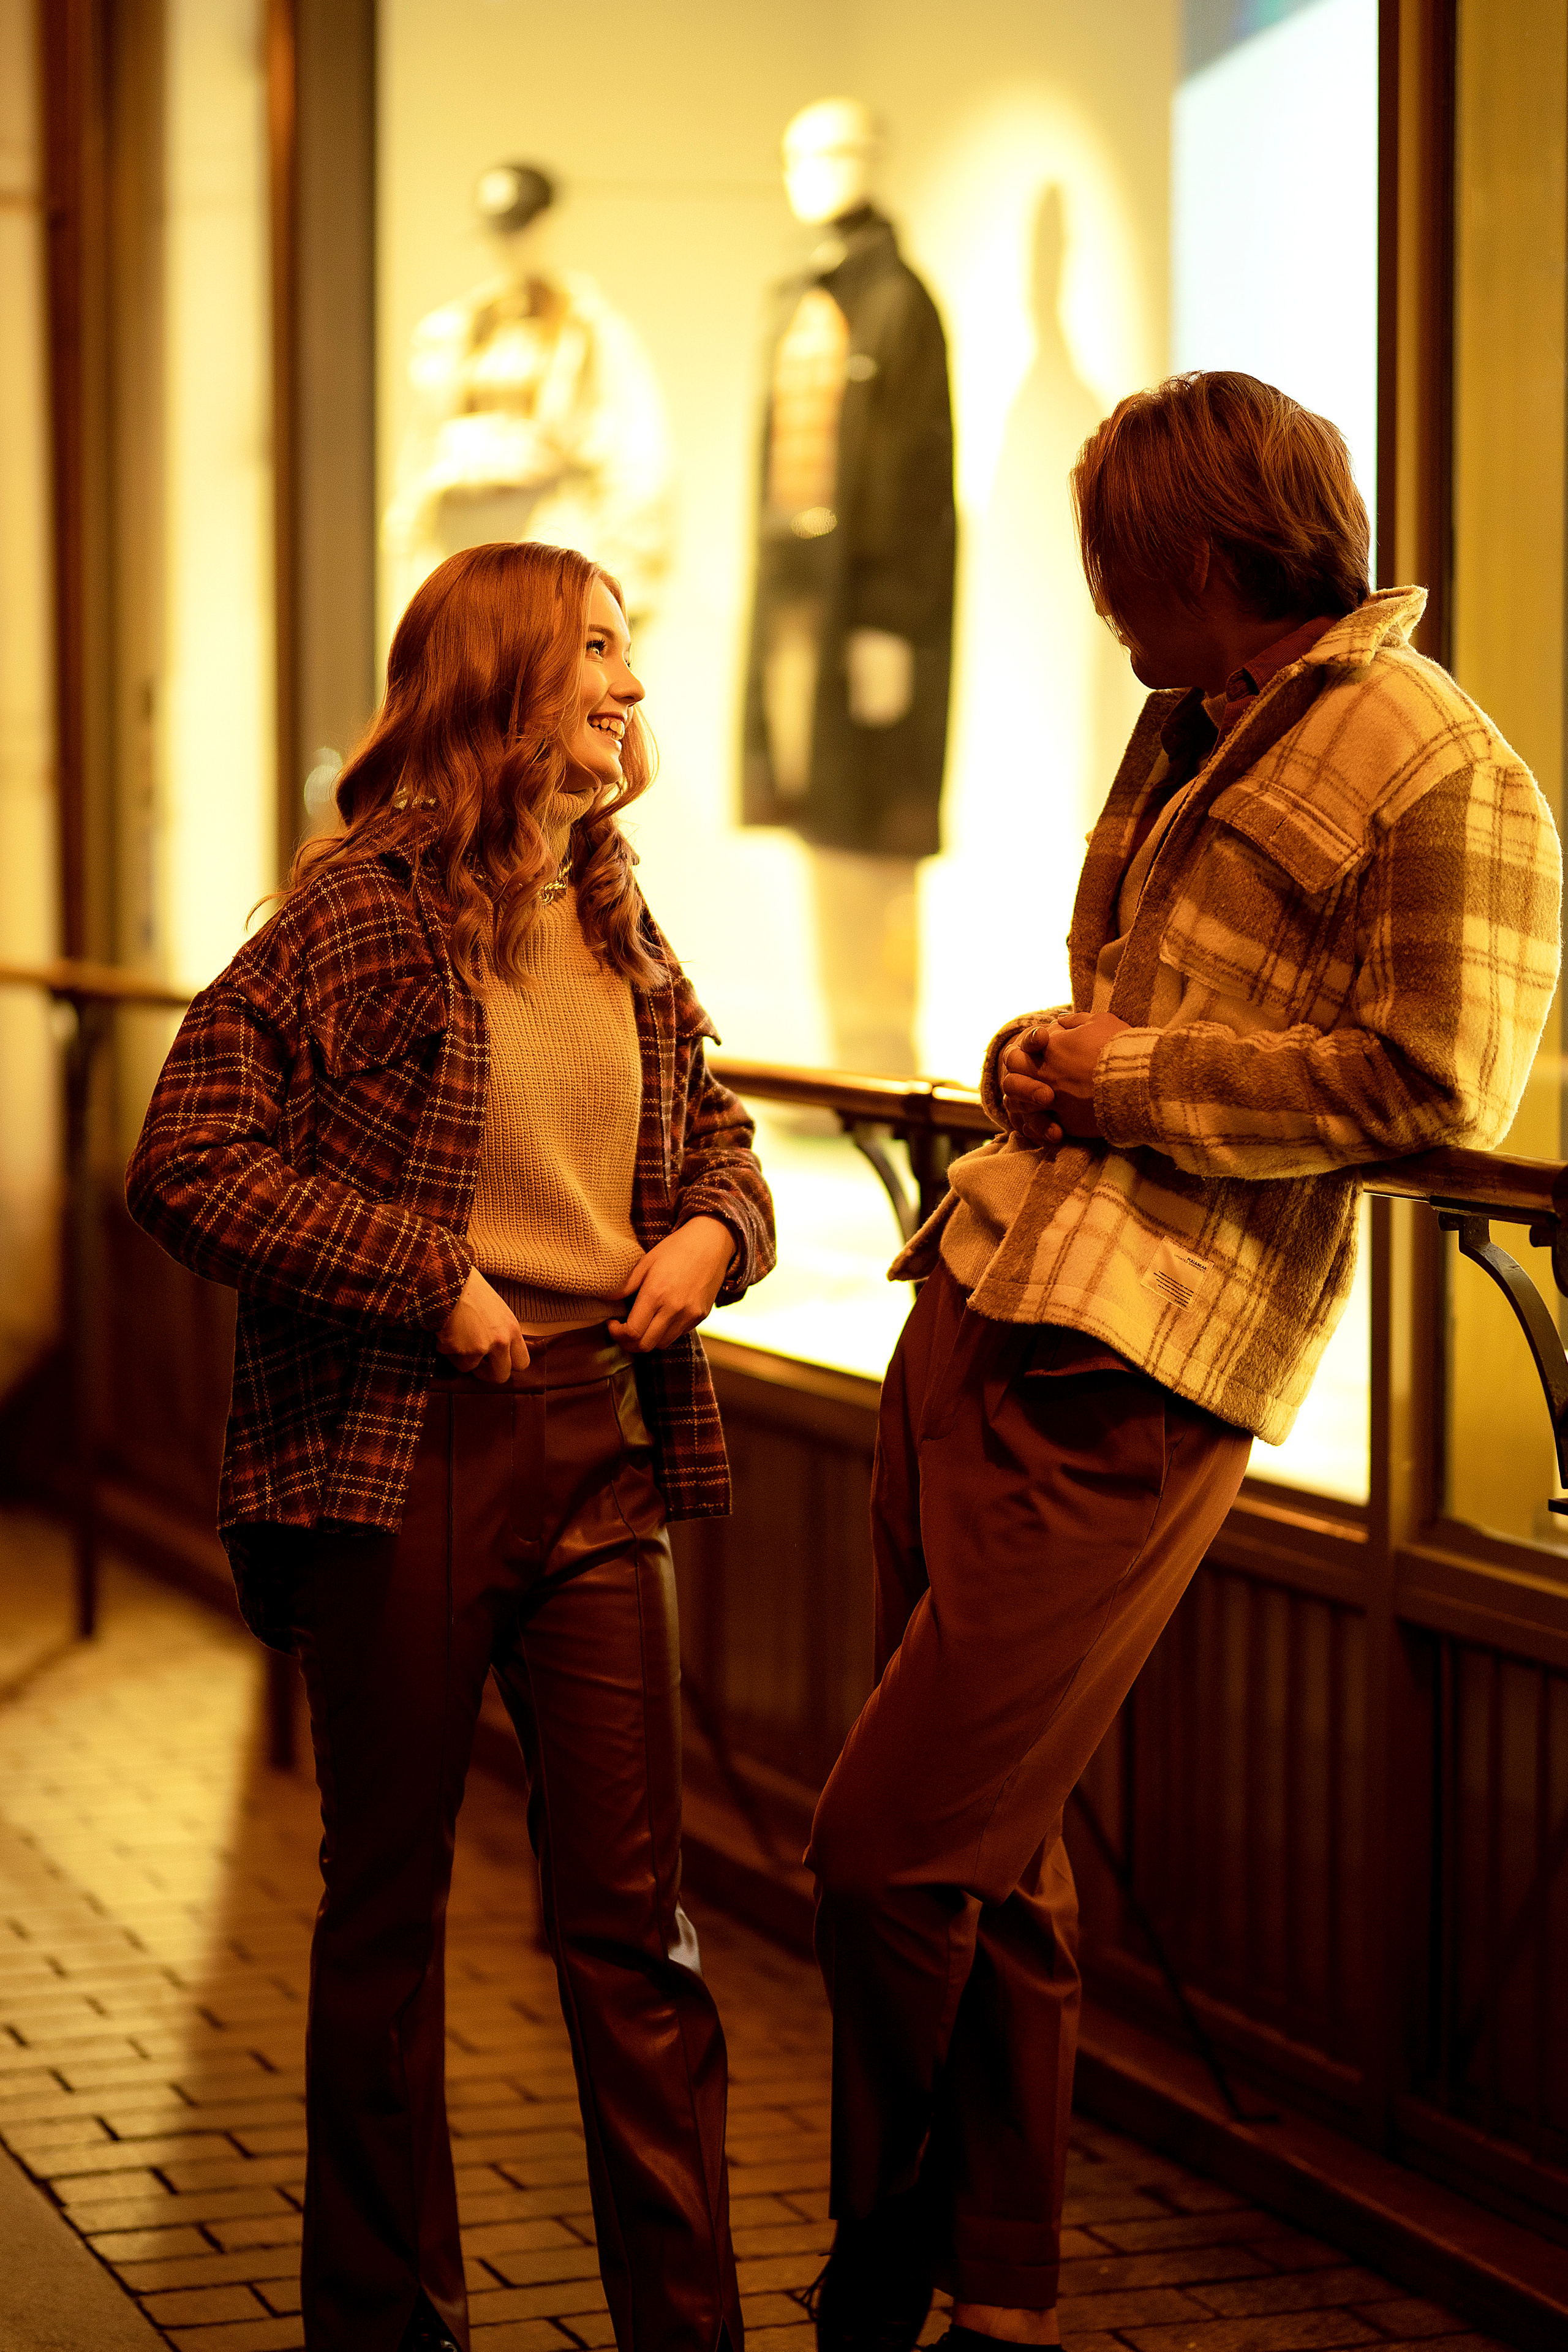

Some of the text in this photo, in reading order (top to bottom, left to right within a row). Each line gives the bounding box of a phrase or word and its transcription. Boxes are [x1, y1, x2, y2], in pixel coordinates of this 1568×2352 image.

[1174, 1254, 1205, 1273] UPDATED GARMENTS
[1187, 1257, 1207, 1270] PULL&BEAR
